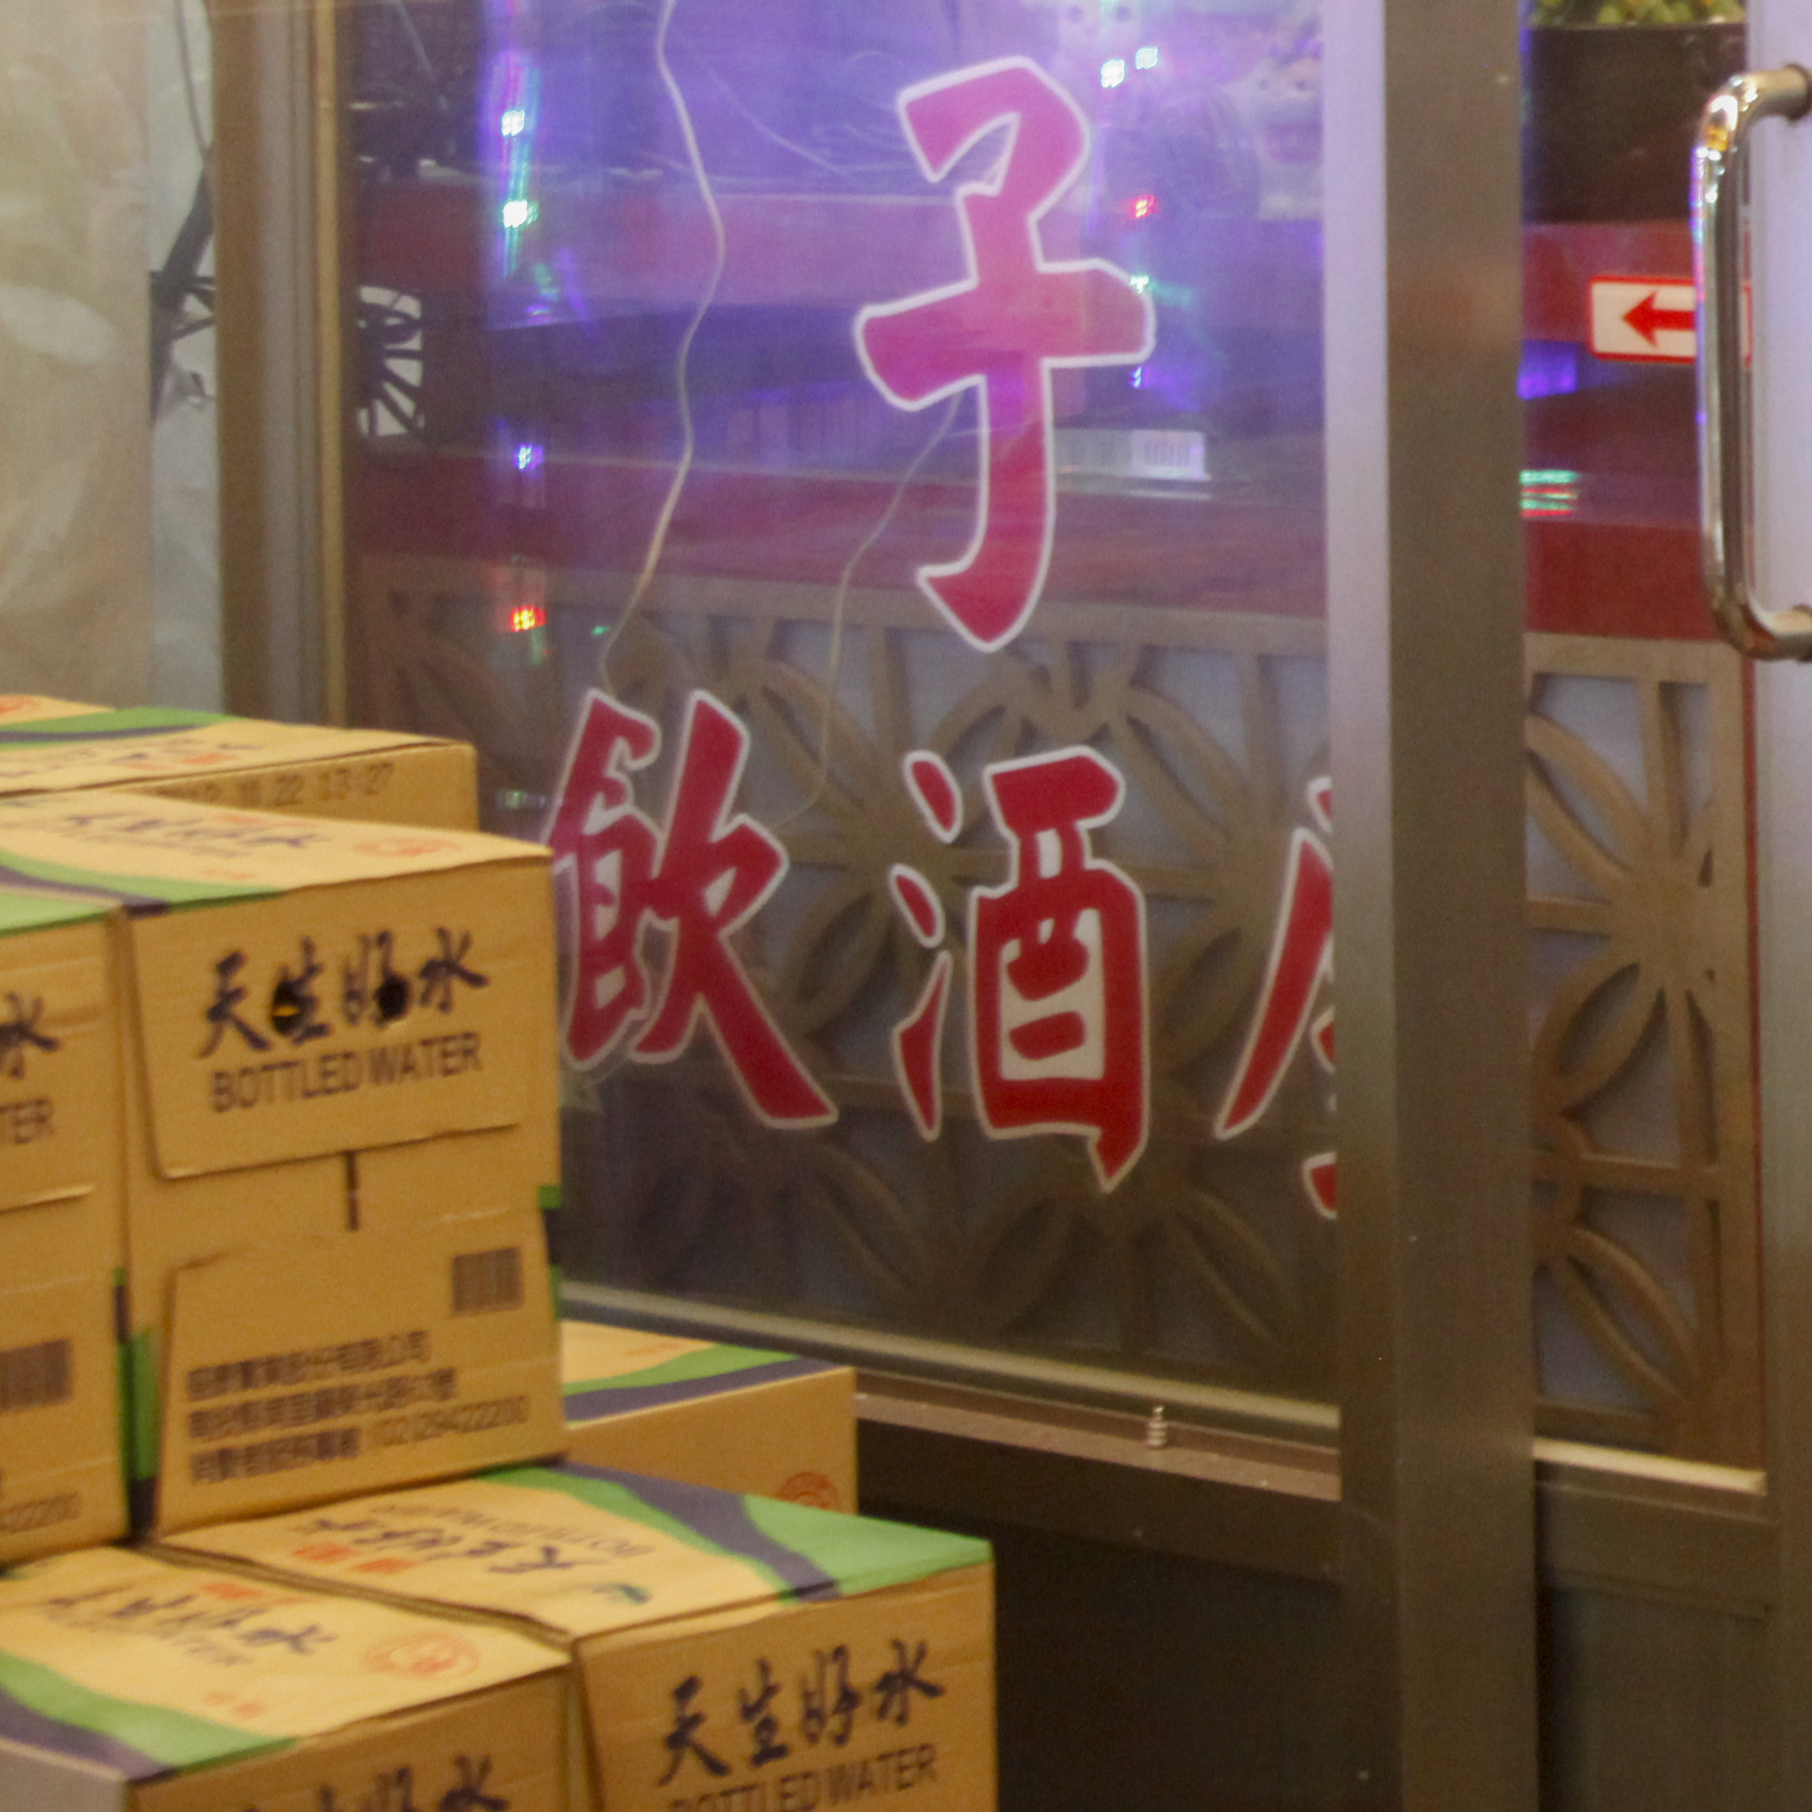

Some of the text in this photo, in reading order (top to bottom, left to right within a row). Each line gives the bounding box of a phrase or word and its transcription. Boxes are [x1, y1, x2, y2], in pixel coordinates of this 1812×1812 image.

[211, 1030, 484, 1114] BOTTLED WATER
[657, 1638, 946, 1788] 天生好水
[824, 1743, 938, 1806] WATER
